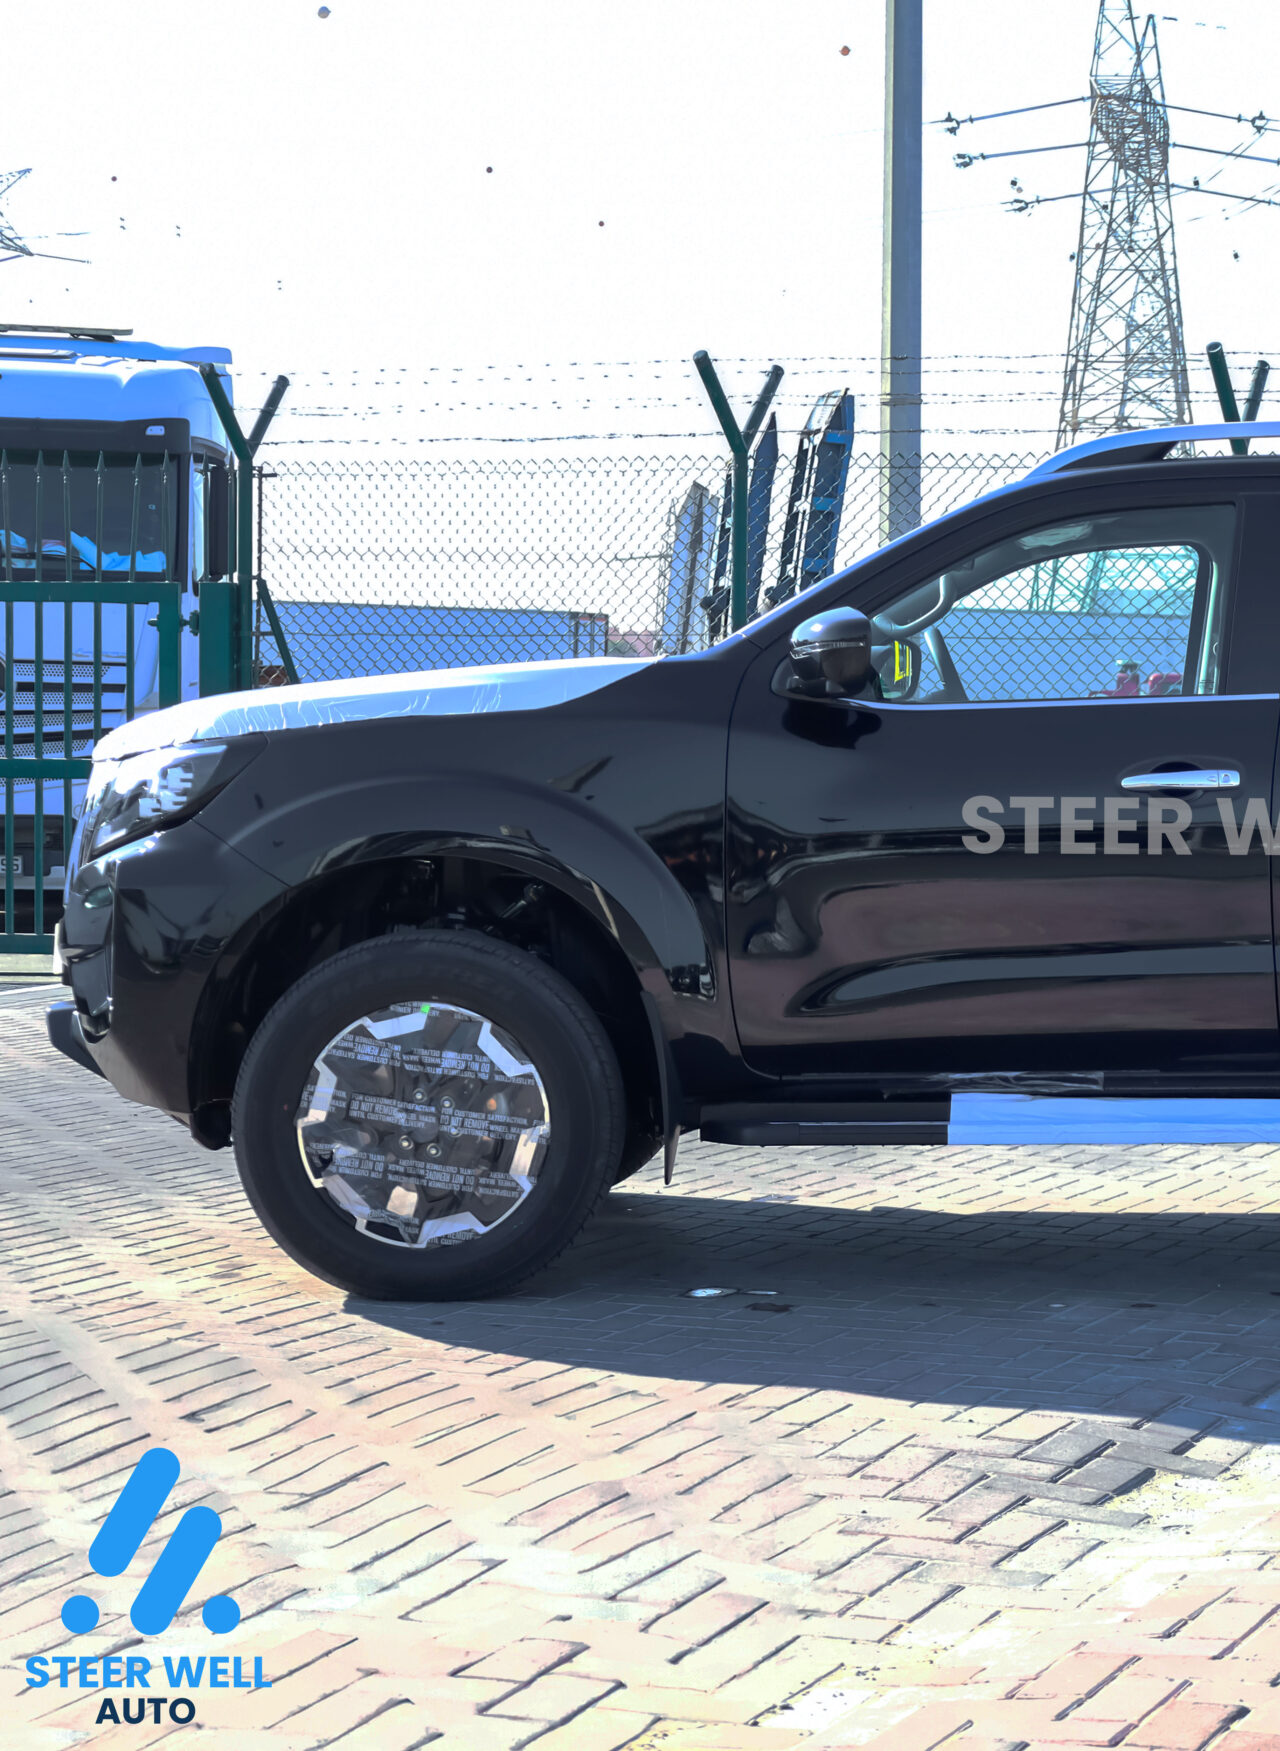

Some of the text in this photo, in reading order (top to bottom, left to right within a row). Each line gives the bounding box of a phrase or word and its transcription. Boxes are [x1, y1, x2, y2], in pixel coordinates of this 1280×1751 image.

[353, 1043, 379, 1055] REMOVE
[440, 1058, 465, 1069] REMOVE
[467, 1062, 479, 1071] NOT
[481, 1063, 490, 1072] DO
[360, 1103, 373, 1112] NOT
[440, 1115, 449, 1124] DO
[464, 1119, 490, 1130] REMOVE
[360, 1159, 373, 1170] NOT
[374, 1162, 384, 1171] DO
[426, 1163, 458, 1172] CUSTOMER
[425, 1170, 450, 1182] REMOVE
[452, 1174, 464, 1184] NOT
[465, 1176, 474, 1185] DO
